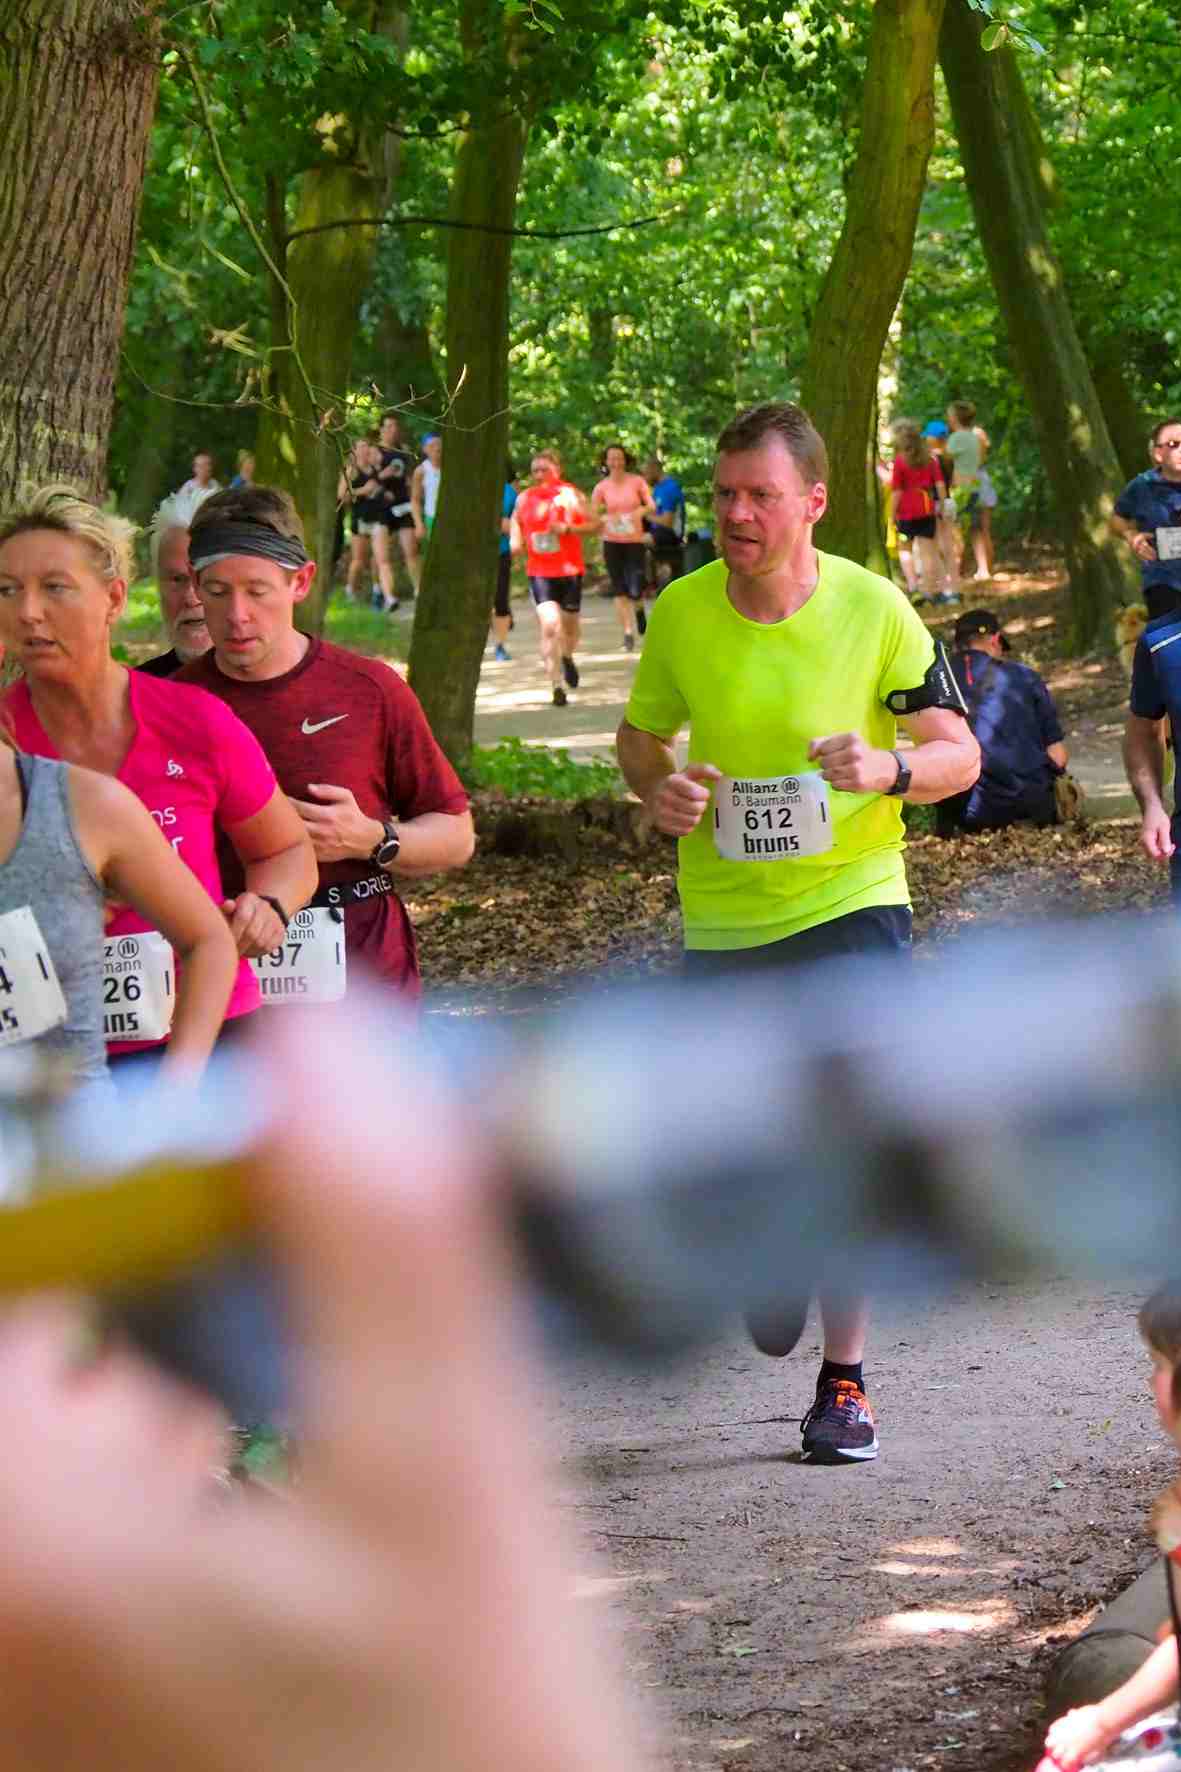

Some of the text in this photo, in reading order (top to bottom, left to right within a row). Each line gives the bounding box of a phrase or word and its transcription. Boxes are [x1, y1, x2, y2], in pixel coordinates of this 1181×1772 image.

[732, 781, 779, 794] Allianz
[744, 807, 794, 831] 612
[743, 832, 800, 854] bruns
[104, 975, 141, 1004] 26
